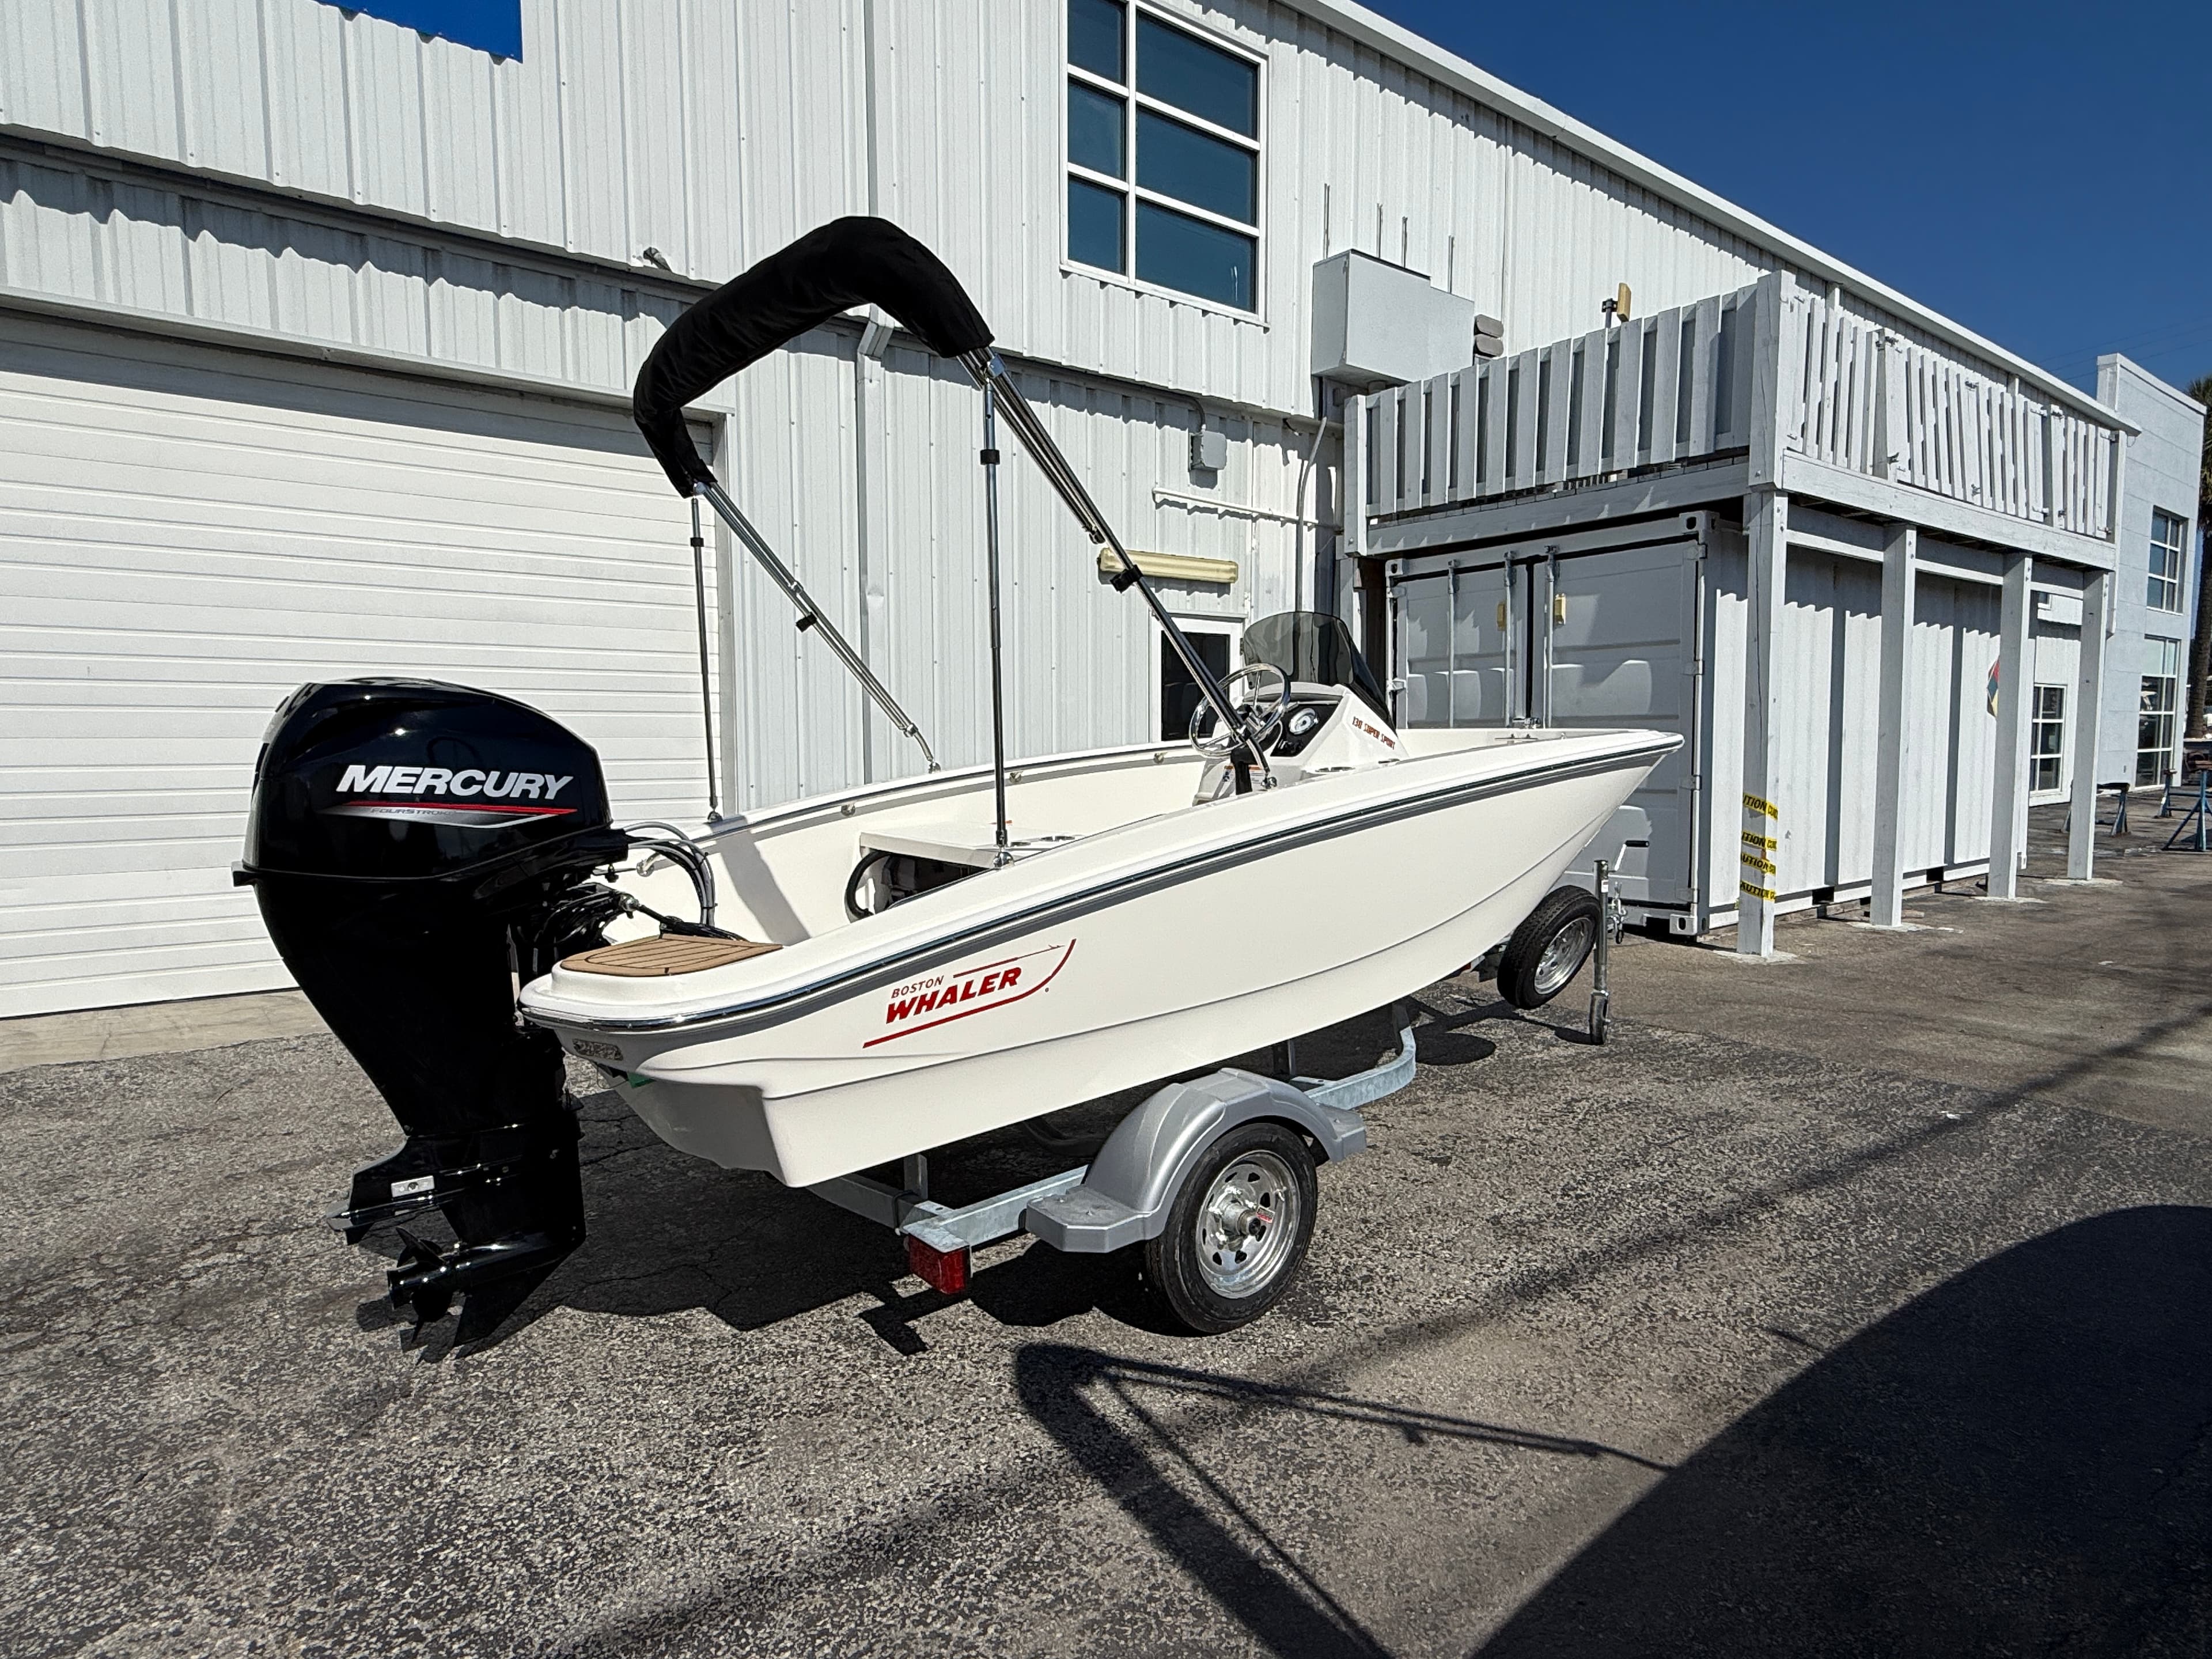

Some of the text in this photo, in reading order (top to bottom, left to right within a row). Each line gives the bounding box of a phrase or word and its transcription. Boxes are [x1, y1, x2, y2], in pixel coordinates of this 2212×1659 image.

[336, 766, 574, 800] MERCURY
[1741, 854, 1768, 870] UTION
[886, 967, 1022, 1024] WHALER
[892, 976, 944, 998] BOSTON
